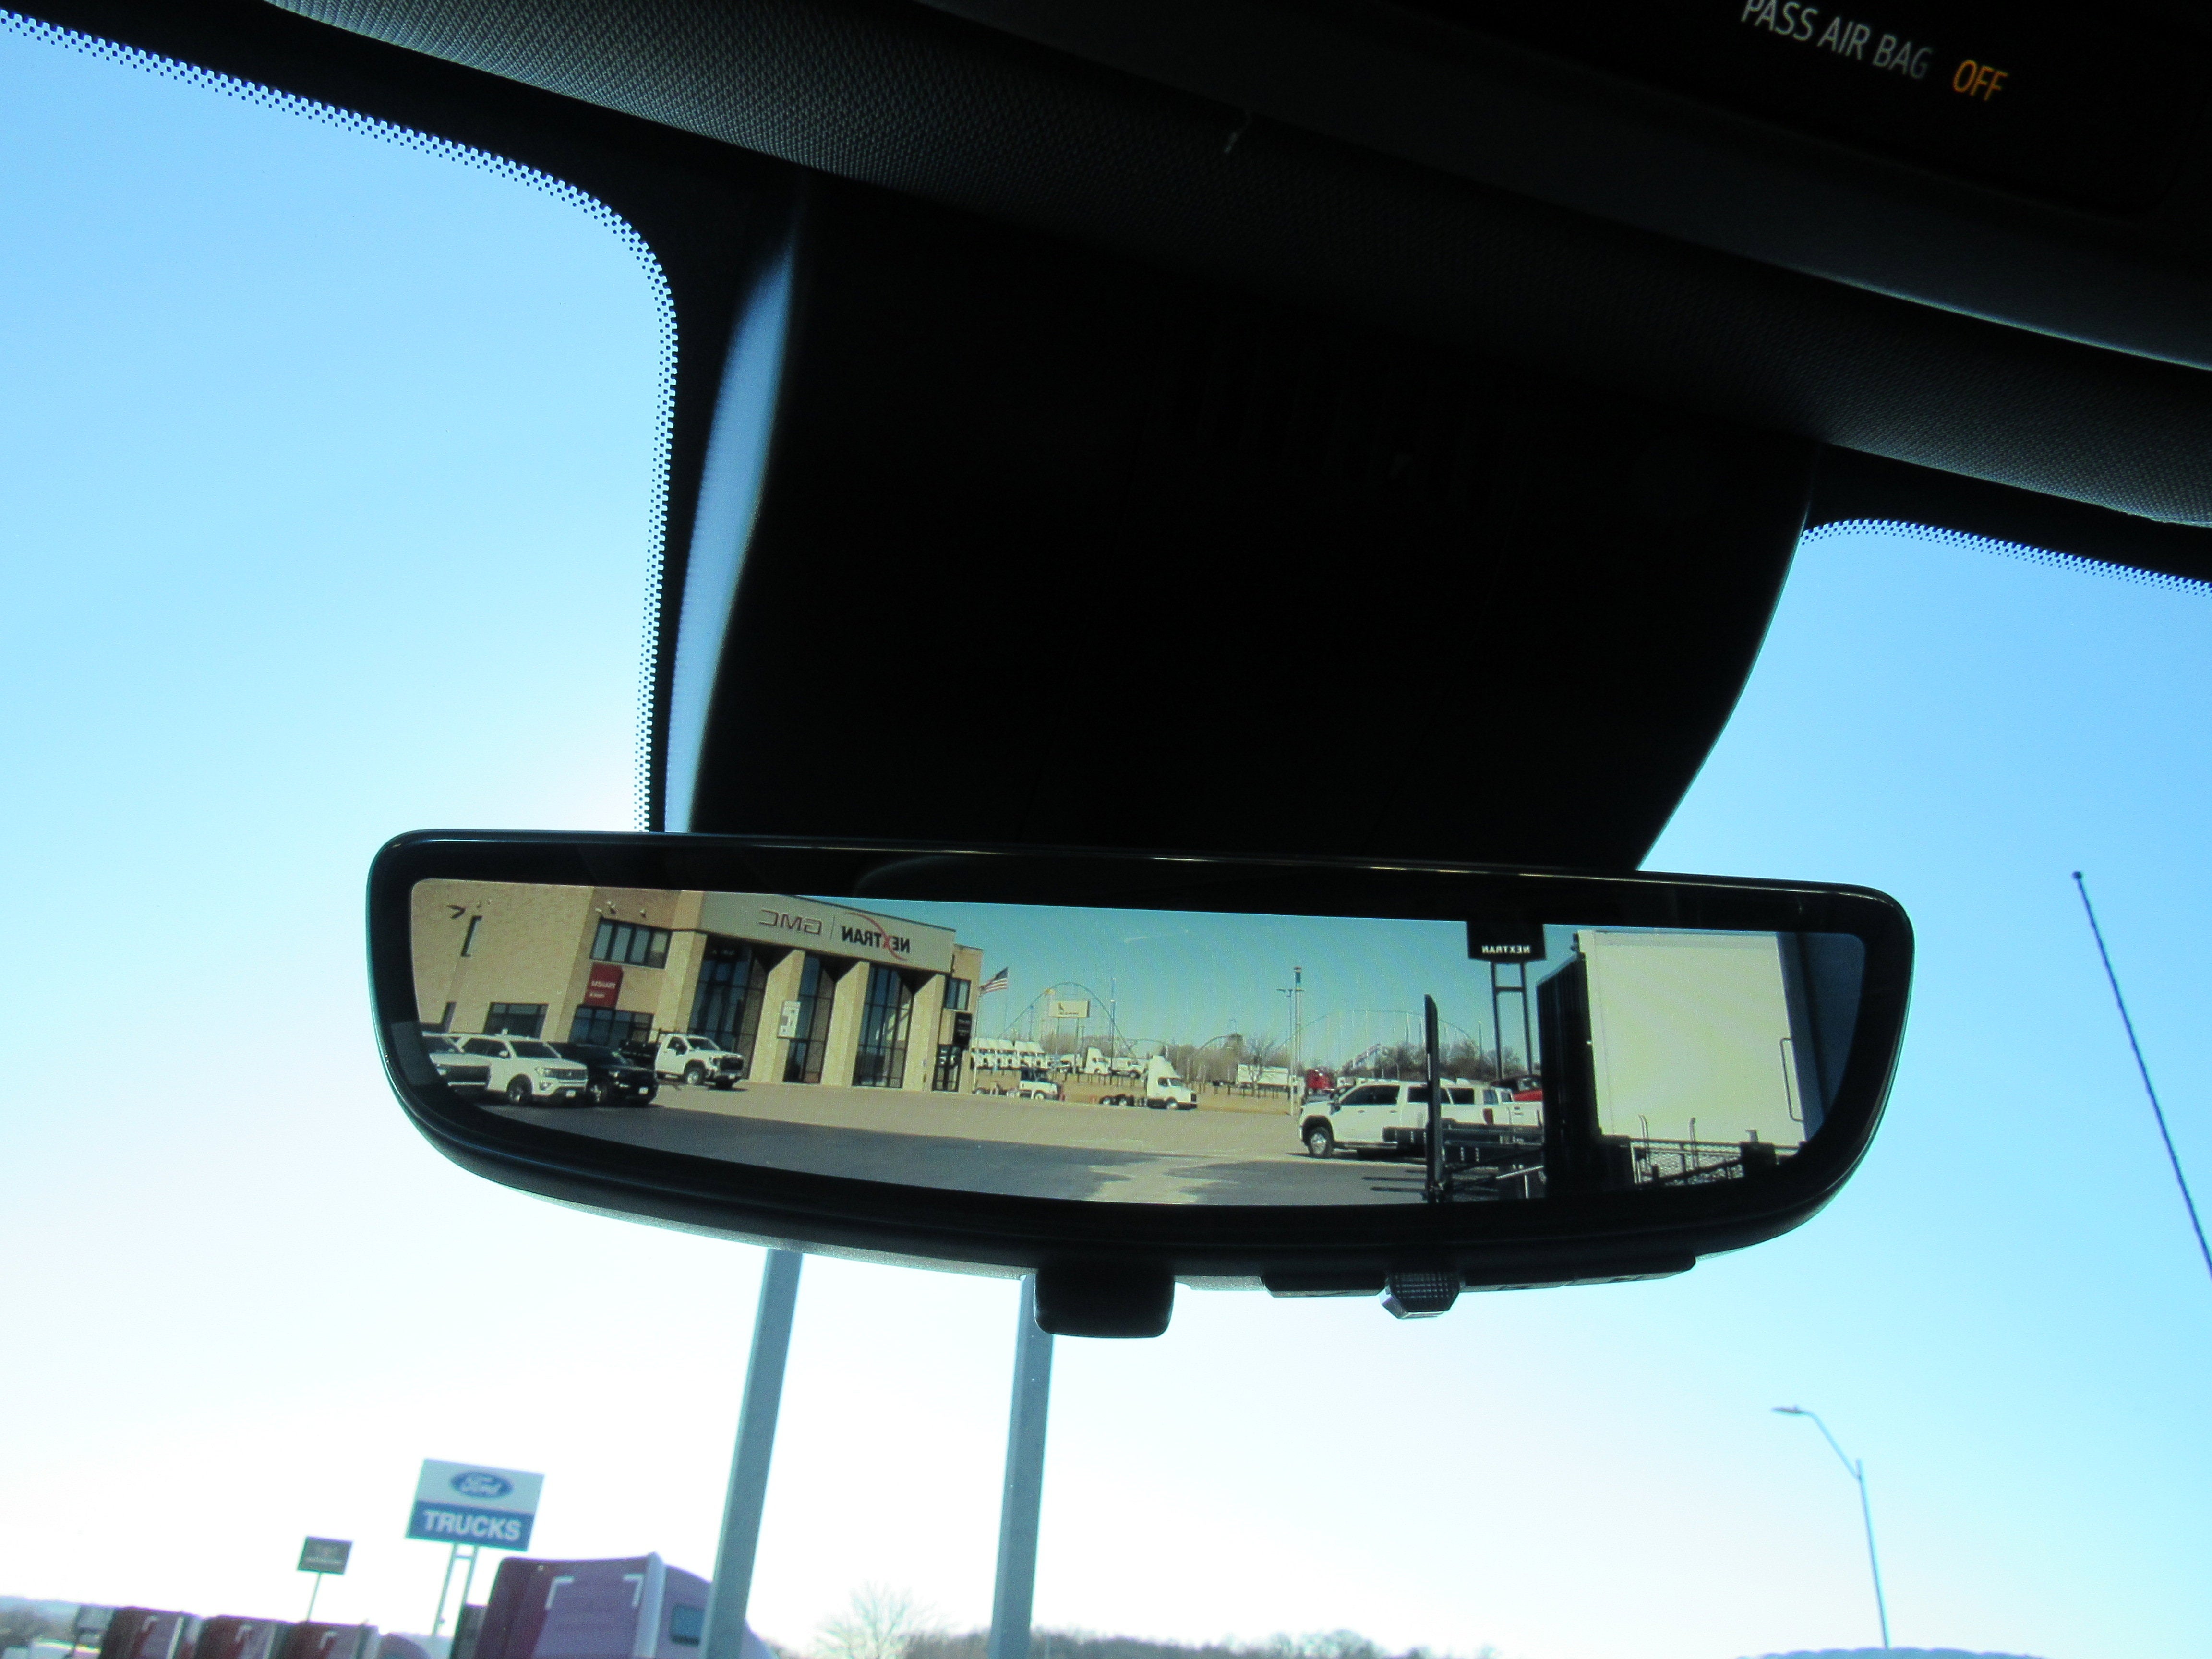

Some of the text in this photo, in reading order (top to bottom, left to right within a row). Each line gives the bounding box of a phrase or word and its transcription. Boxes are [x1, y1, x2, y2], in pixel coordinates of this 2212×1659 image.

[1741, 0, 2008, 100] PASS AIR BAG OFF
[423, 1510, 521, 1541] TRUCKS
